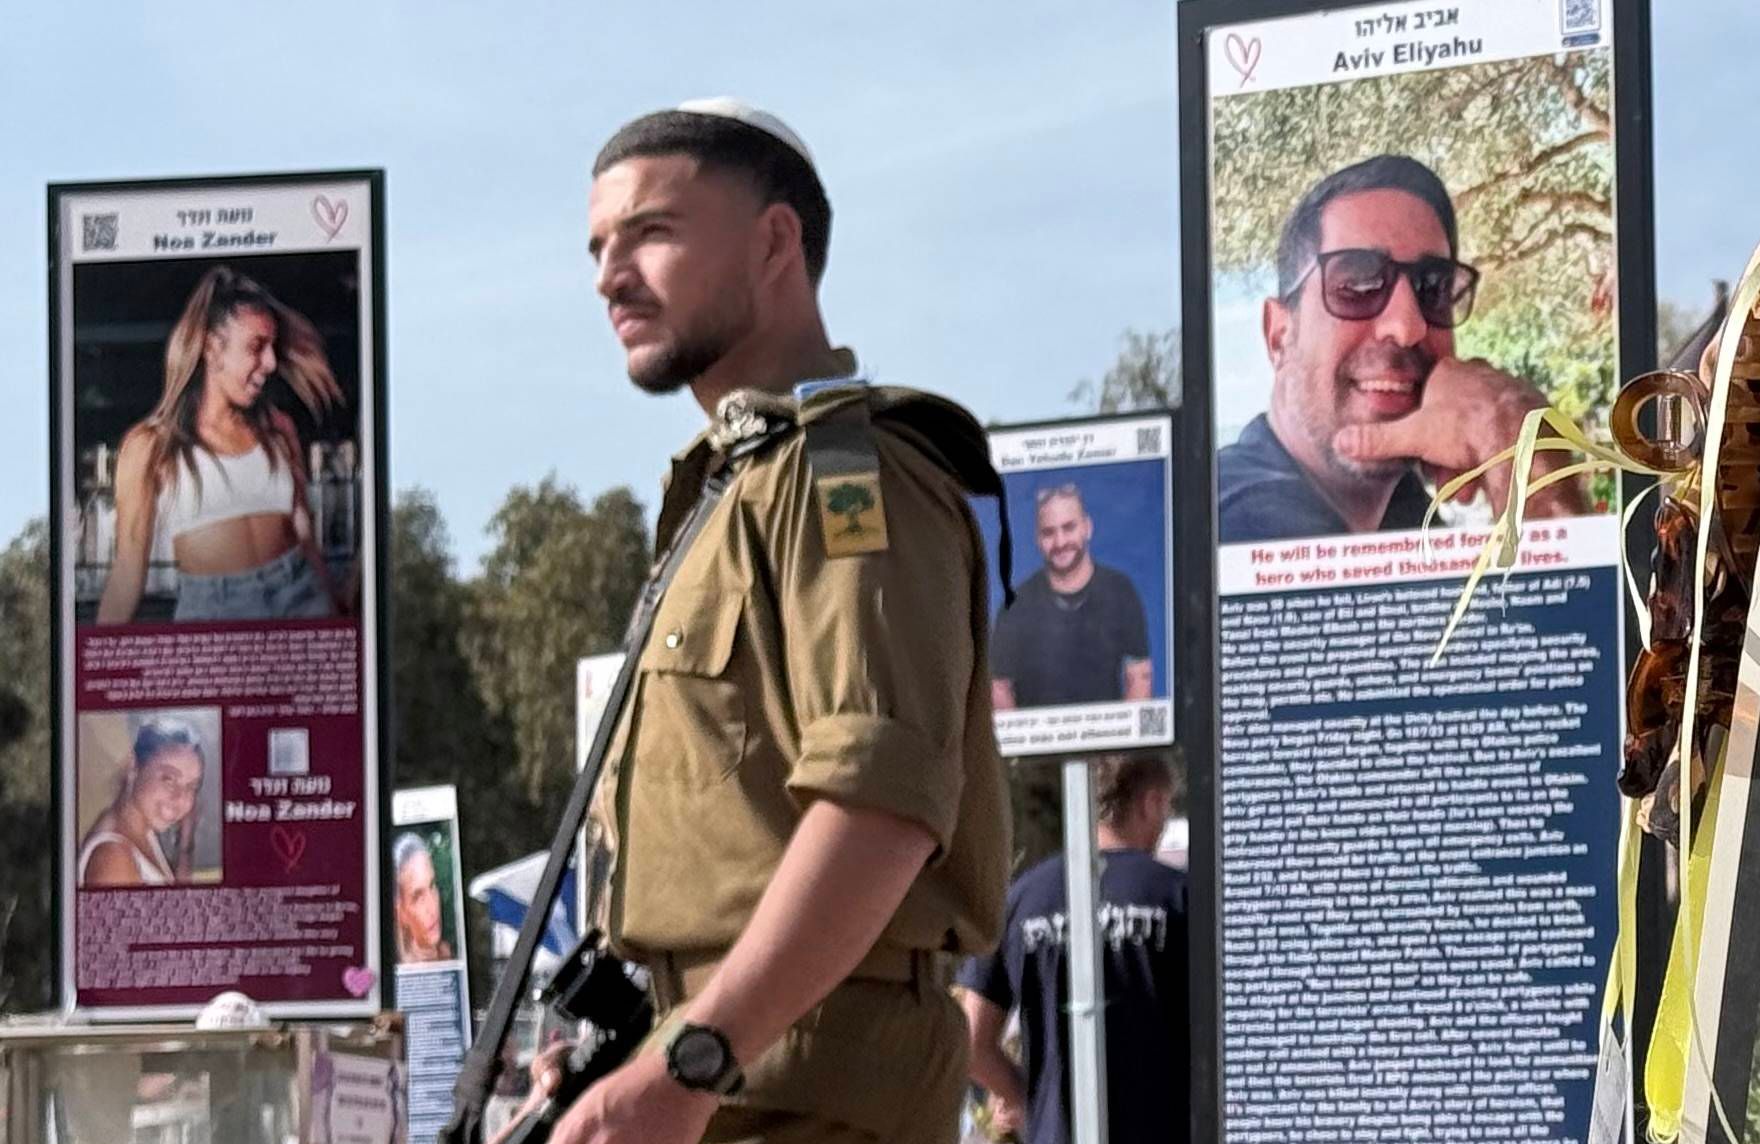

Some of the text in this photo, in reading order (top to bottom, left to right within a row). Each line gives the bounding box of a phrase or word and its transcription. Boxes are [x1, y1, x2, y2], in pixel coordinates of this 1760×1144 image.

[1355, 8, 1459, 37] אביב אליהו
[1333, 36, 1483, 72] Aviv Eliyahu
[1251, 549, 1274, 564] He
[1279, 546, 1310, 562] will
[1316, 543, 1337, 560] be
[1256, 571, 1295, 585] hero
[1300, 565, 1337, 582] who
[1343, 561, 1393, 579] saved
